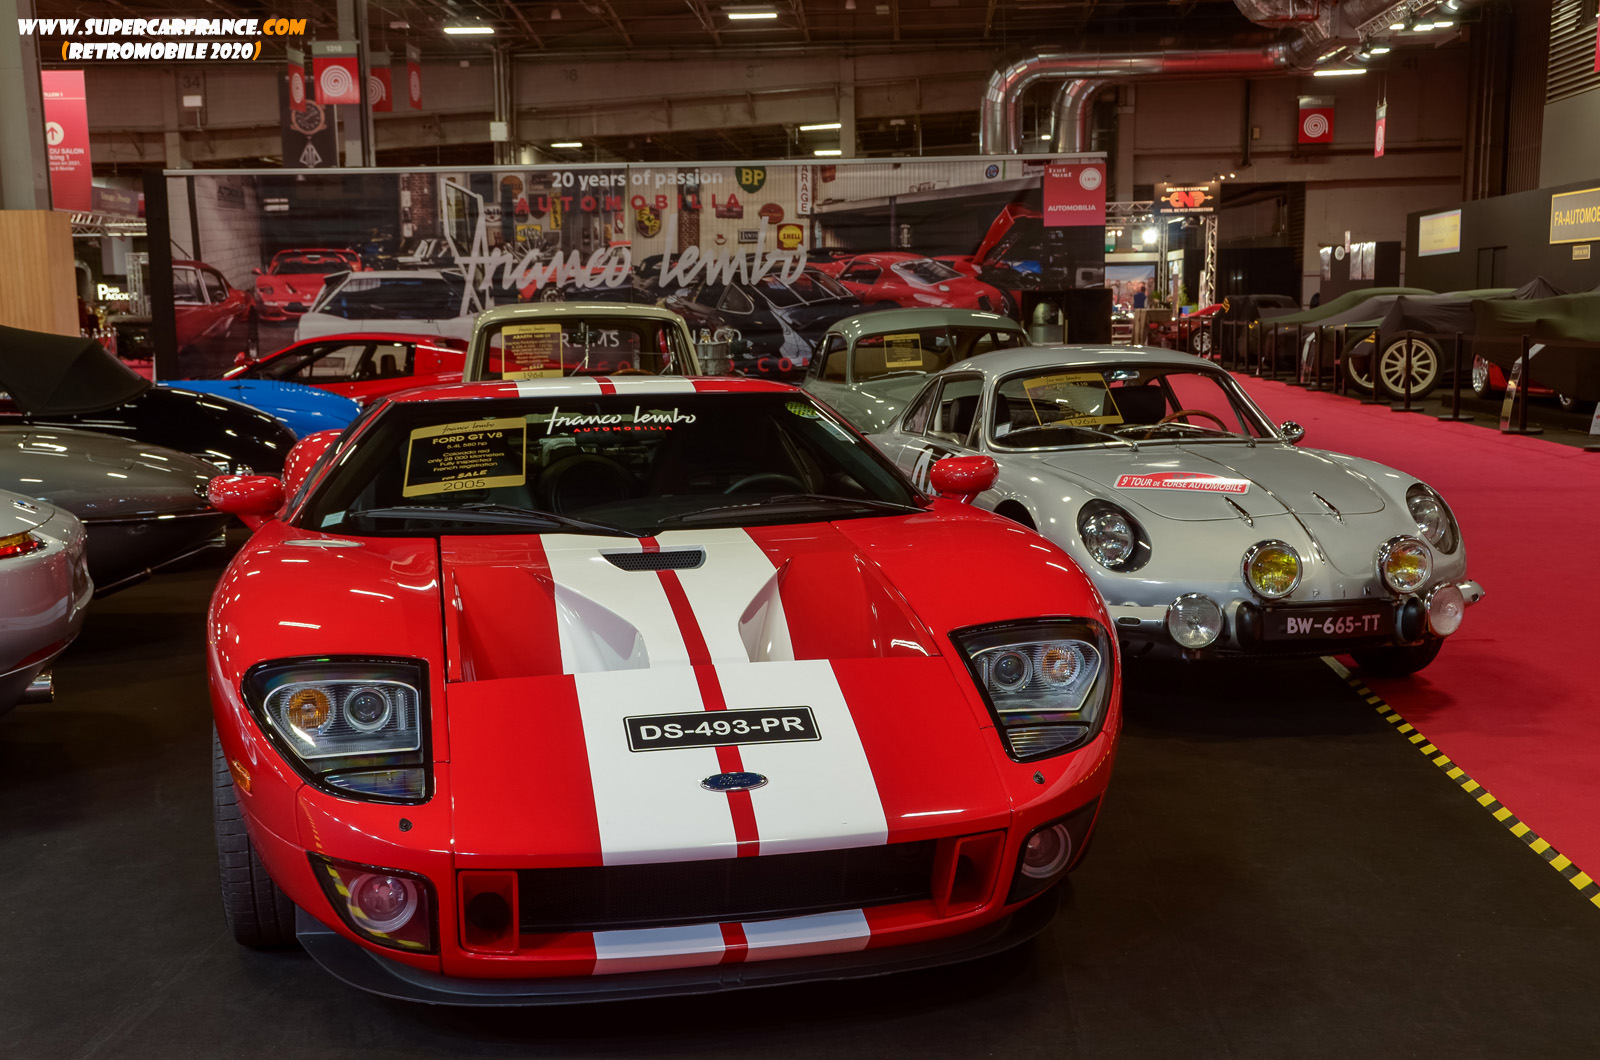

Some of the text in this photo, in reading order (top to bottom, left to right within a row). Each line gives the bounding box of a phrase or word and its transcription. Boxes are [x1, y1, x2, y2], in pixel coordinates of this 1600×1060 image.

[183, 76, 200, 88] 34
[552, 168, 723, 191] 20 years of passion
[741, 168, 764, 185] BP
[515, 192, 741, 214] AUTOMOBILIA
[1048, 204, 1097, 212] AUTOMOBILIA
[455, 203, 808, 317] franco lembo
[523, 371, 544, 379] 1964
[543, 405, 697, 435] franco lembo
[1068, 418, 1097, 426] 1964
[573, 425, 673, 433] AUTOMOBILIA
[432, 435, 465, 445] FORD
[486, 431, 503, 439] V8
[456, 457, 492, 465] inspected
[459, 461, 498, 470] registration
[456, 469, 488, 479] SALE
[443, 480, 486, 491] 2005
[1131, 477, 1153, 487] TOUR
[1187, 481, 1243, 492] AUTOMOBILE
[1286, 614, 1381, 634] BW-665-TT
[639, 716, 805, 741] DS-493-PR
